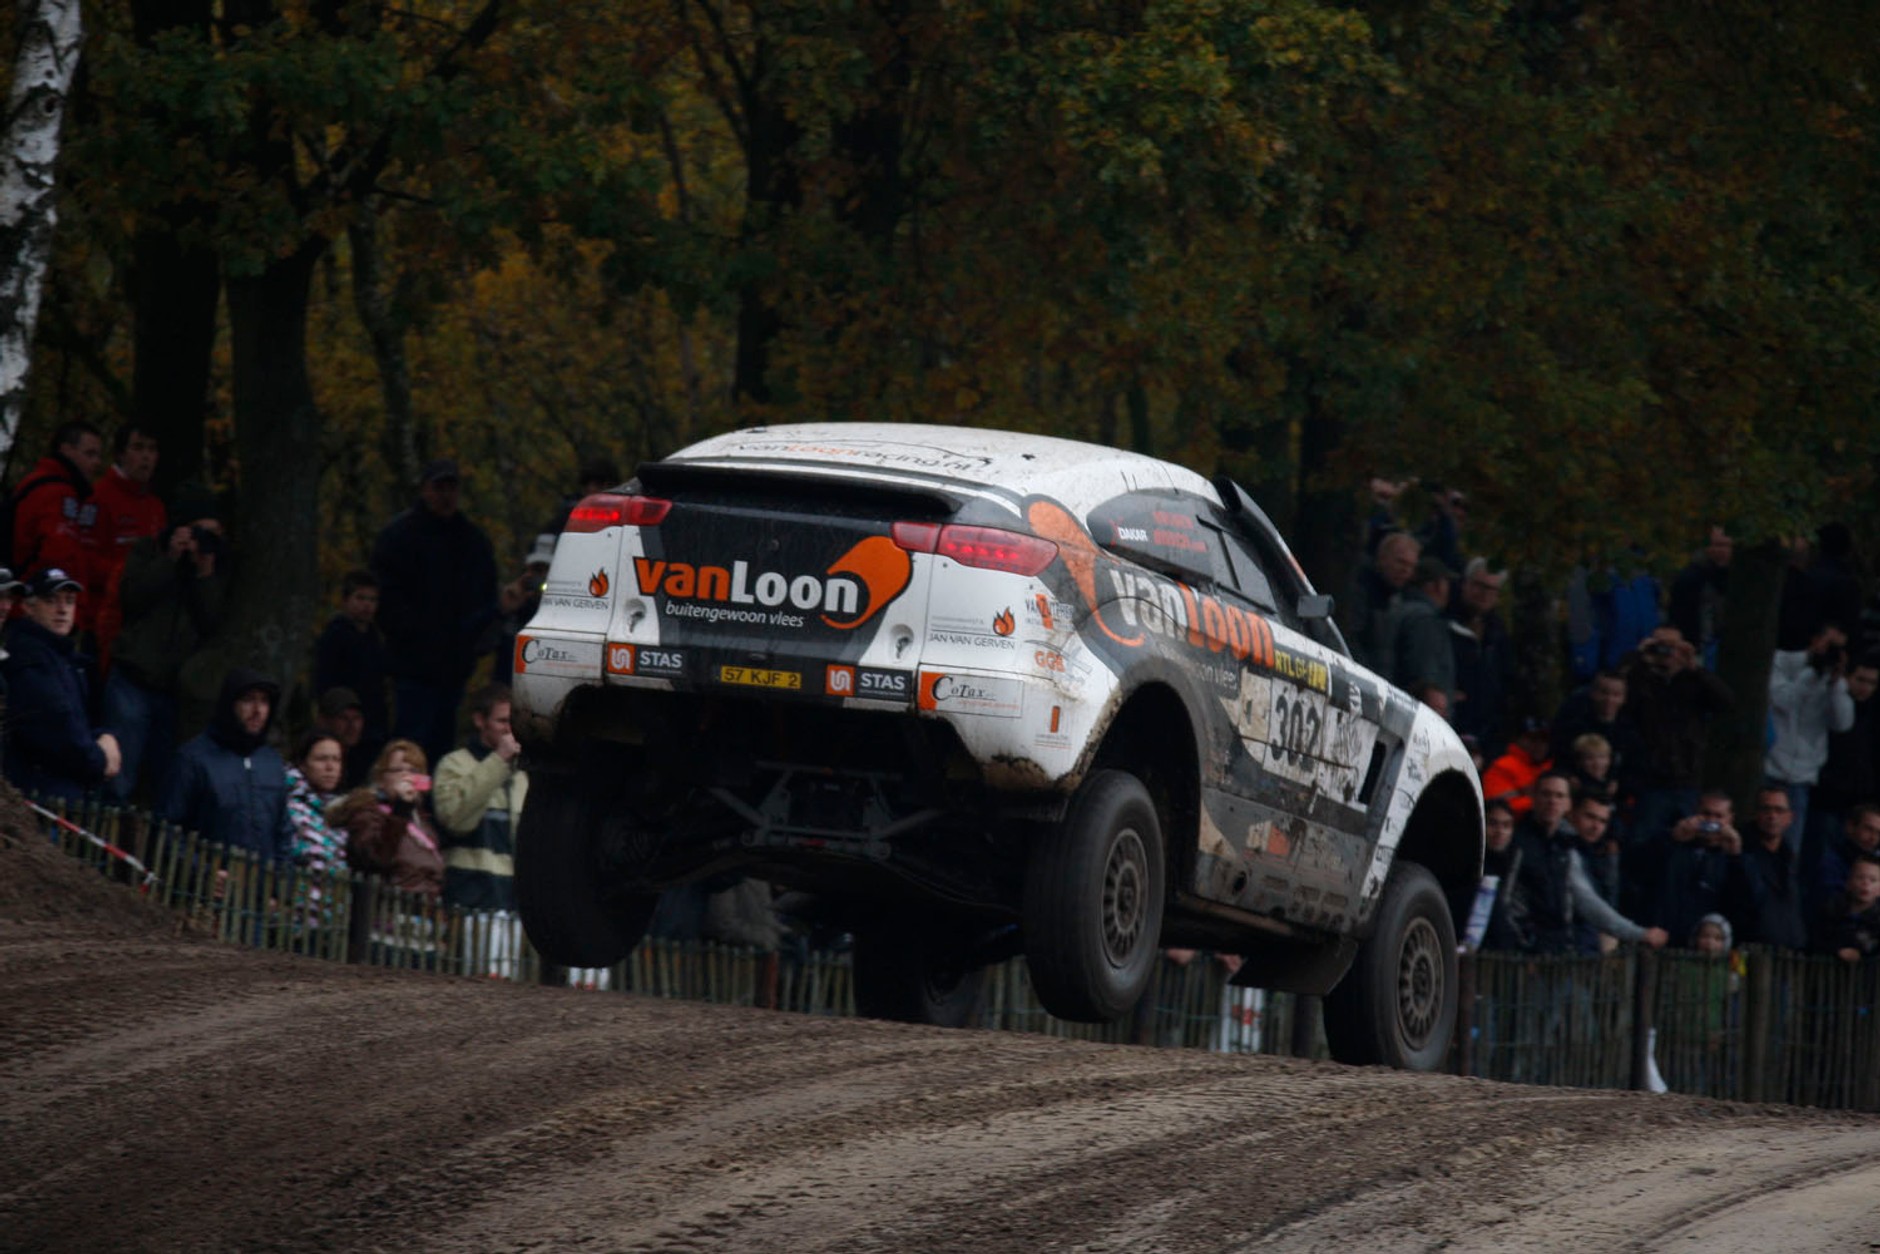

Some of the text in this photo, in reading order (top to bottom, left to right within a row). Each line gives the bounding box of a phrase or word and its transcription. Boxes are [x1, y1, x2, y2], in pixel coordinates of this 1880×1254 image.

[1117, 527, 1148, 542] DAKAR
[665, 601, 804, 628] buitengewoon vlees
[974, 637, 1015, 649] GERVEN
[639, 650, 683, 668] STAS
[723, 668, 744, 681] 57
[788, 673, 798, 687] 2
[859, 672, 906, 691] STAS
[1270, 694, 1321, 773] 302
